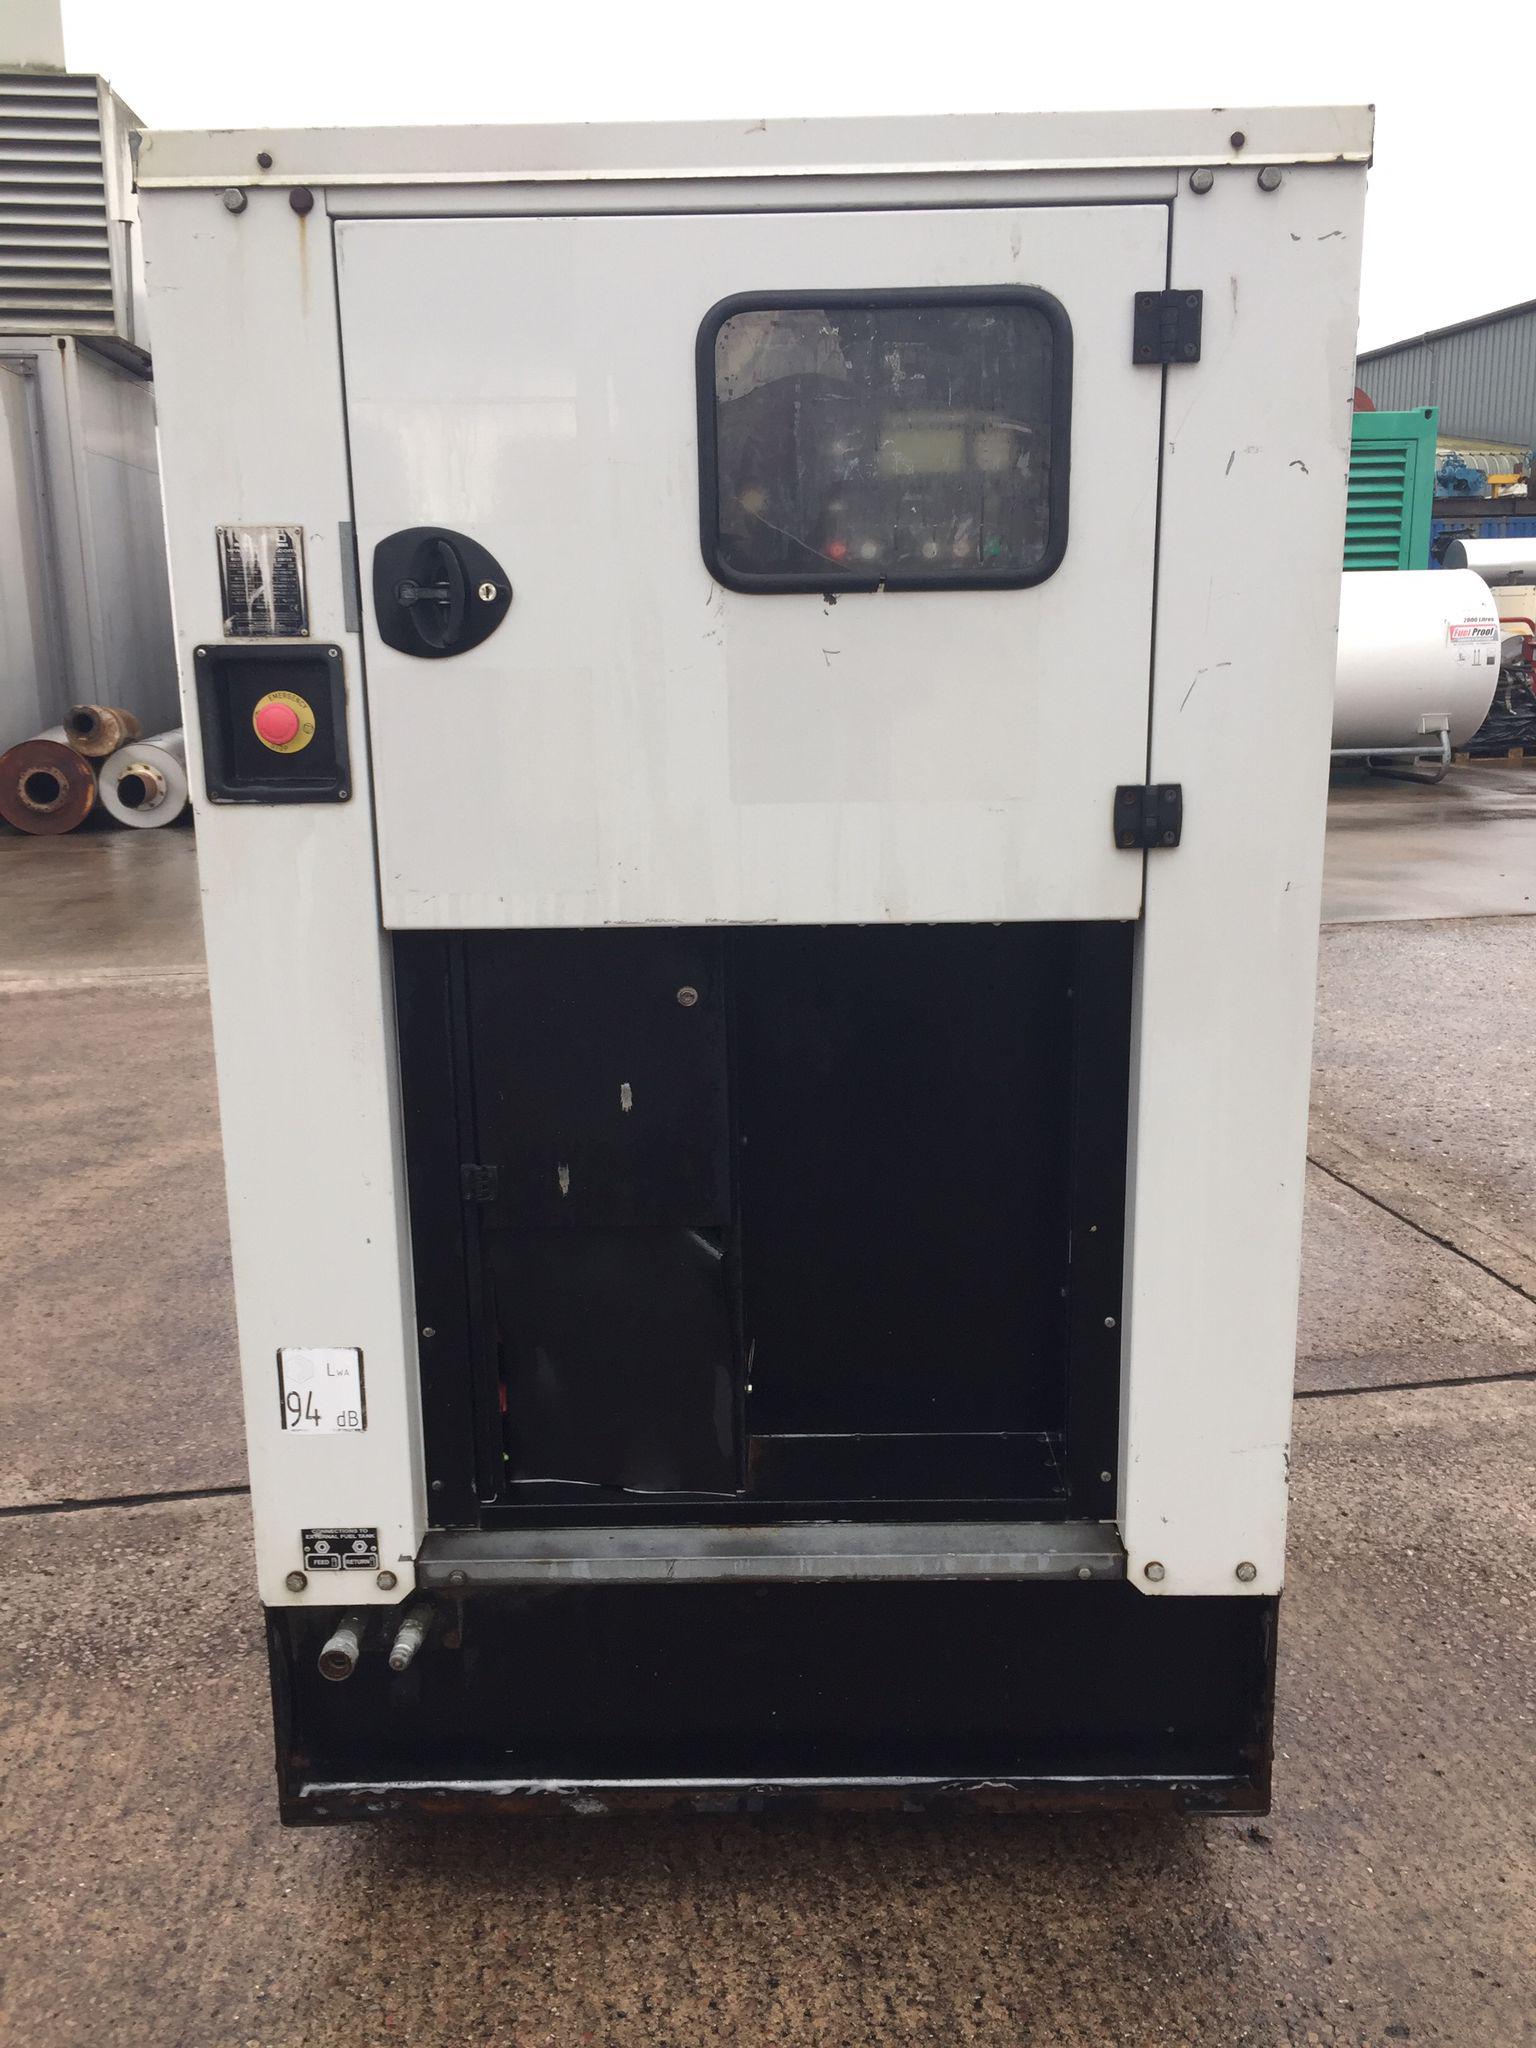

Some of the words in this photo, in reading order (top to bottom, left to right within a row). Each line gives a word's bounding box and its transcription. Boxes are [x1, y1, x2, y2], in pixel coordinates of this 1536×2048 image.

[267, 692, 307, 709] EMERGENCY
[286, 1391, 321, 1427] 94
[337, 1410, 359, 1427] dB
